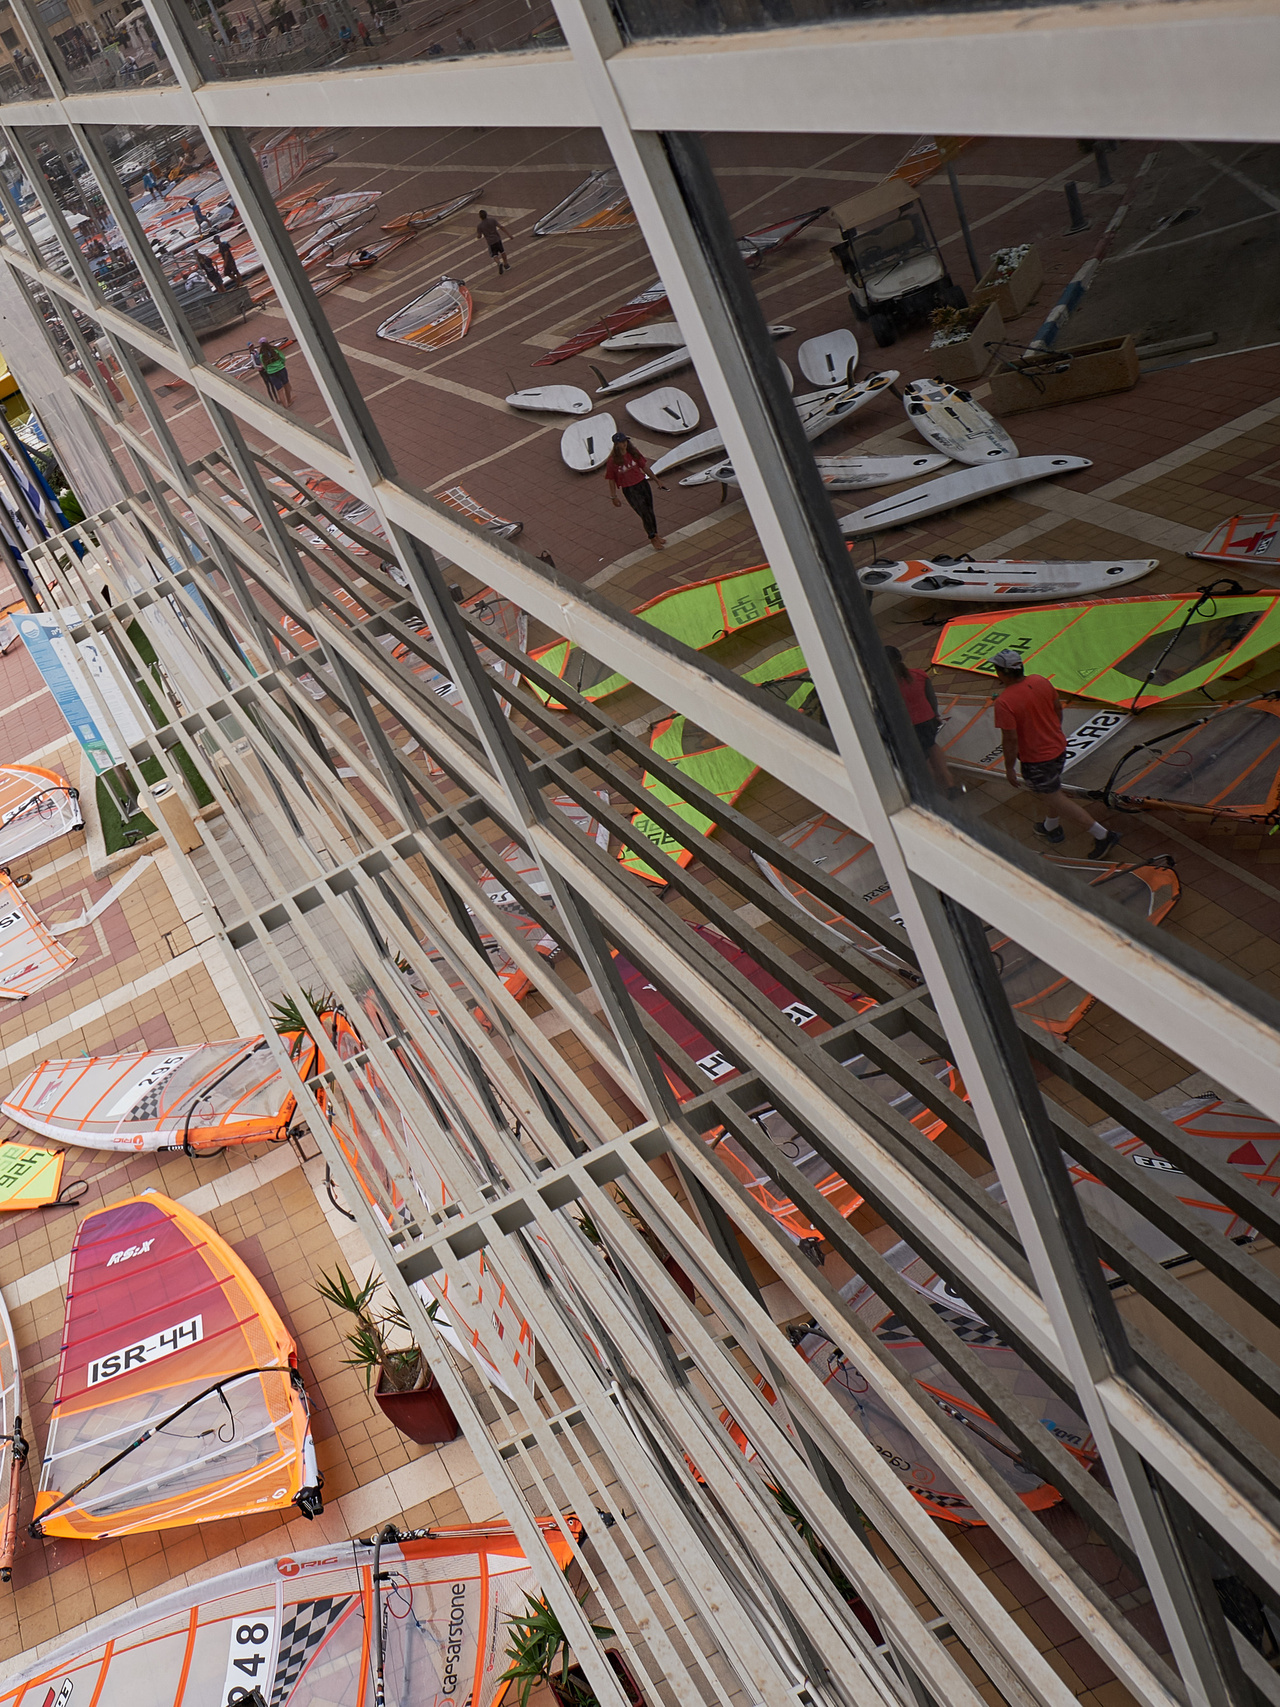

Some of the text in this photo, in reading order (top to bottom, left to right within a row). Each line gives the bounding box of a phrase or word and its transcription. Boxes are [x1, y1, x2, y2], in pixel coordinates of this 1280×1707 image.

[138, 1056, 183, 1086] 295
[106, 1239, 155, 1267] RS:X
[91, 1321, 198, 1383] ISR-44
[300, 1556, 338, 1570] RIG
[442, 1583, 465, 1695] caesarstone
